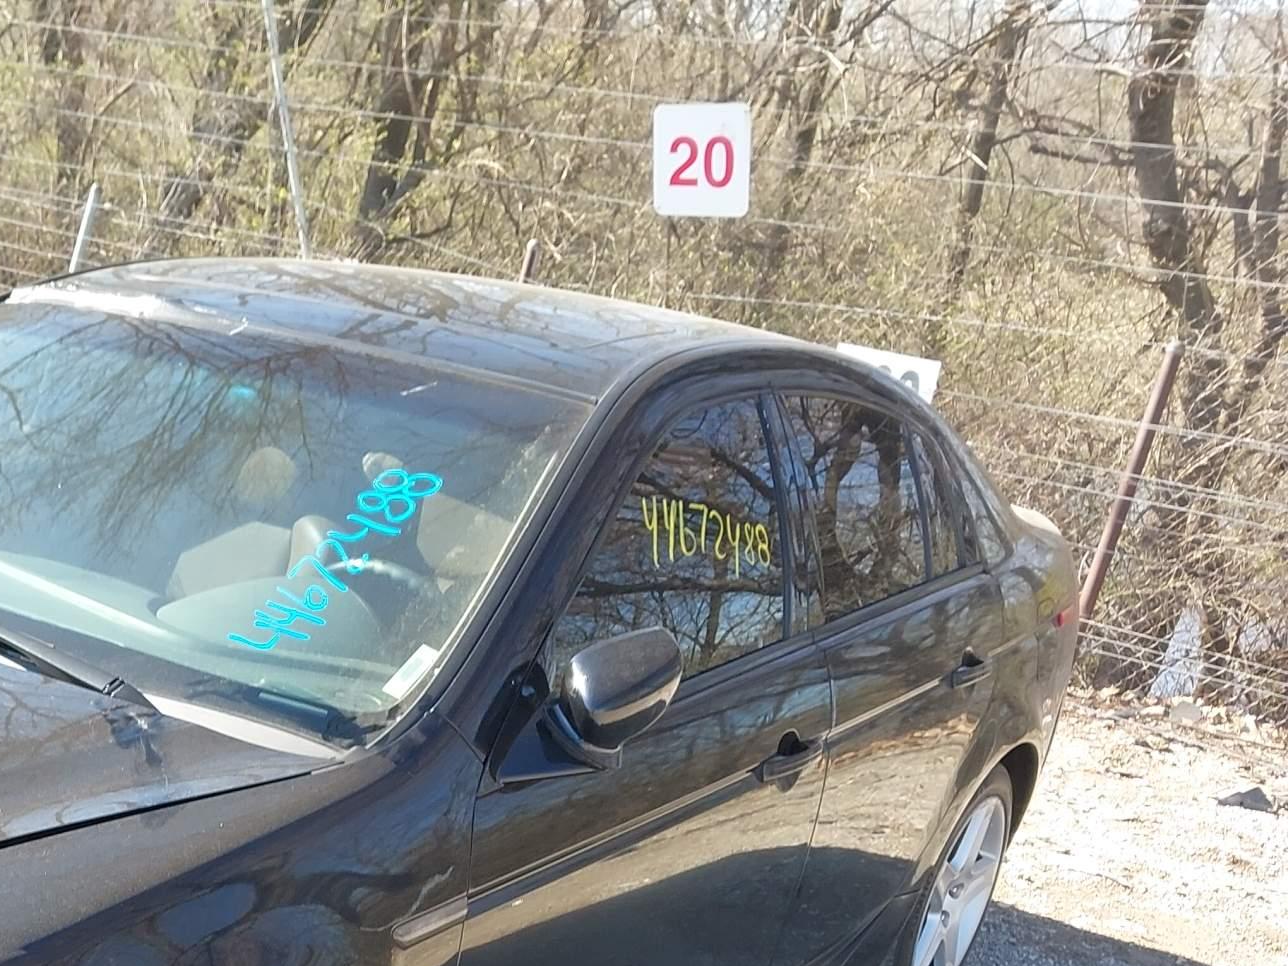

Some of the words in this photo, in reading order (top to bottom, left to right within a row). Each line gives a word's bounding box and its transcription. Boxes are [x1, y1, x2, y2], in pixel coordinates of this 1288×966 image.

[669, 135, 734, 188] 20
[227, 468, 443, 651] 44672488
[642, 495, 770, 579] 44672488
